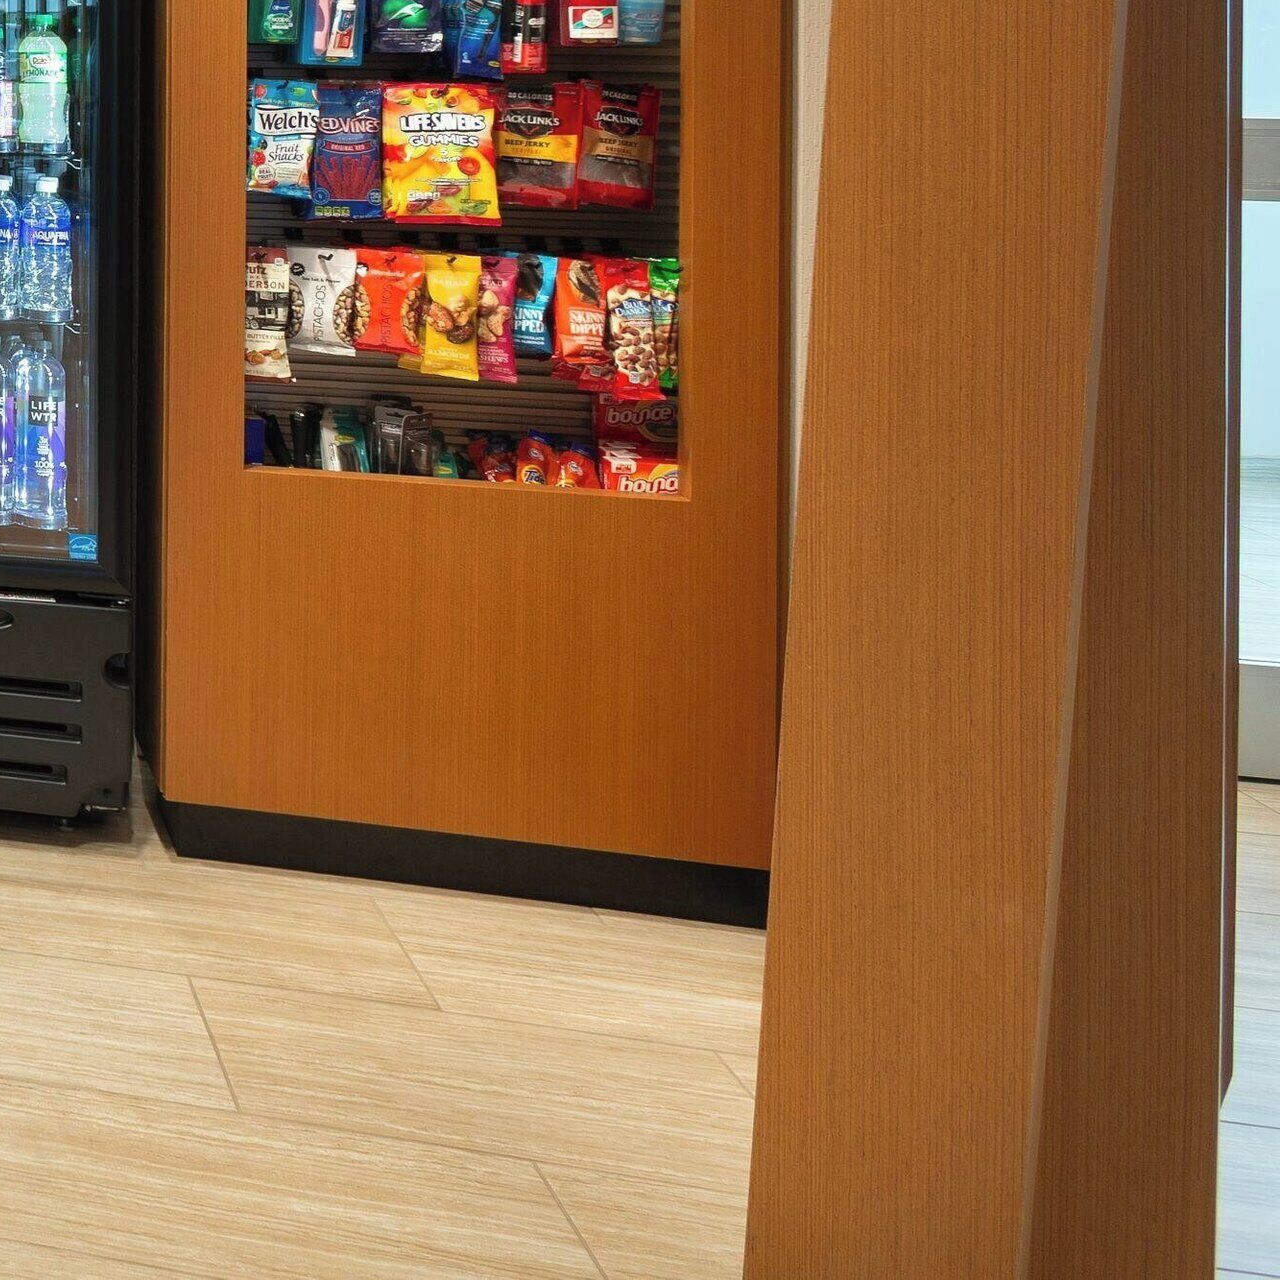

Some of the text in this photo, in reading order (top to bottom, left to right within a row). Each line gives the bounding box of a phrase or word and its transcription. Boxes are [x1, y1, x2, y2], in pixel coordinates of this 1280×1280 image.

[517, 91, 553, 101] CALORIES
[258, 111, 319, 131] Welch's
[400, 112, 486, 133] LIFESAVERS
[499, 113, 560, 127] JACK LINK'S
[595, 111, 619, 122] JACK
[340, 118, 380, 133] VINES
[407, 133, 480, 148] GUMMIES
[504, 139, 551, 149] BEEF JERKY
[274, 143, 300, 154] Fruit
[267, 151, 304, 164] Snacks
[31, 400, 57, 411] LIFE
[31, 412, 57, 422] WTR
[606, 405, 673, 425] bounce
